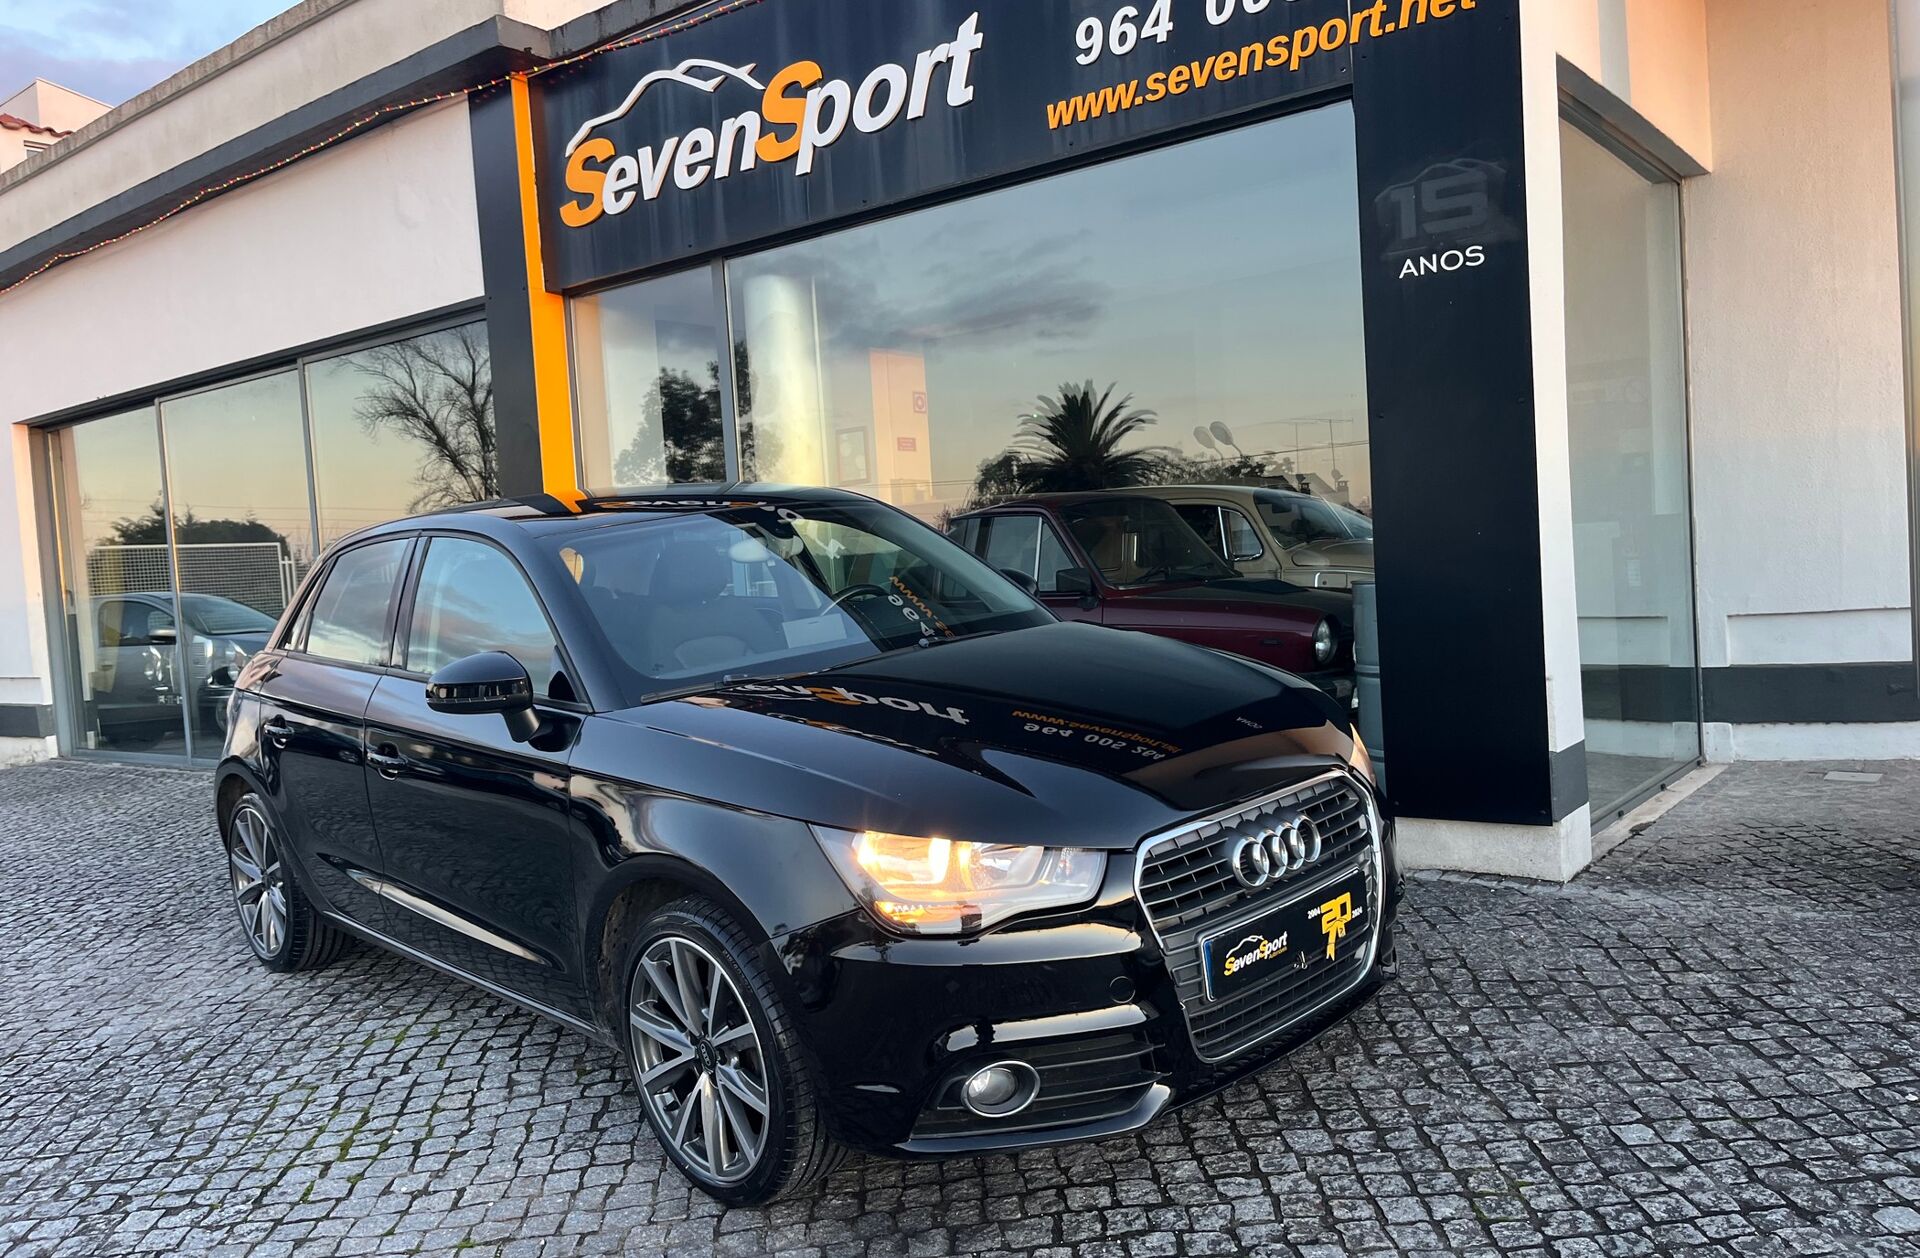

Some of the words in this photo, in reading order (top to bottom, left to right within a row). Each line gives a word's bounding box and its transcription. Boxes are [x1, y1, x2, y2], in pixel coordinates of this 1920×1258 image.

[1046, 0, 1476, 130] www.sevensport.ne
[1075, 0, 1174, 66] 964
[559, 11, 983, 228] SevenSport
[1399, 245, 1485, 279] ANOS
[1224, 931, 1288, 976] SevenSport
